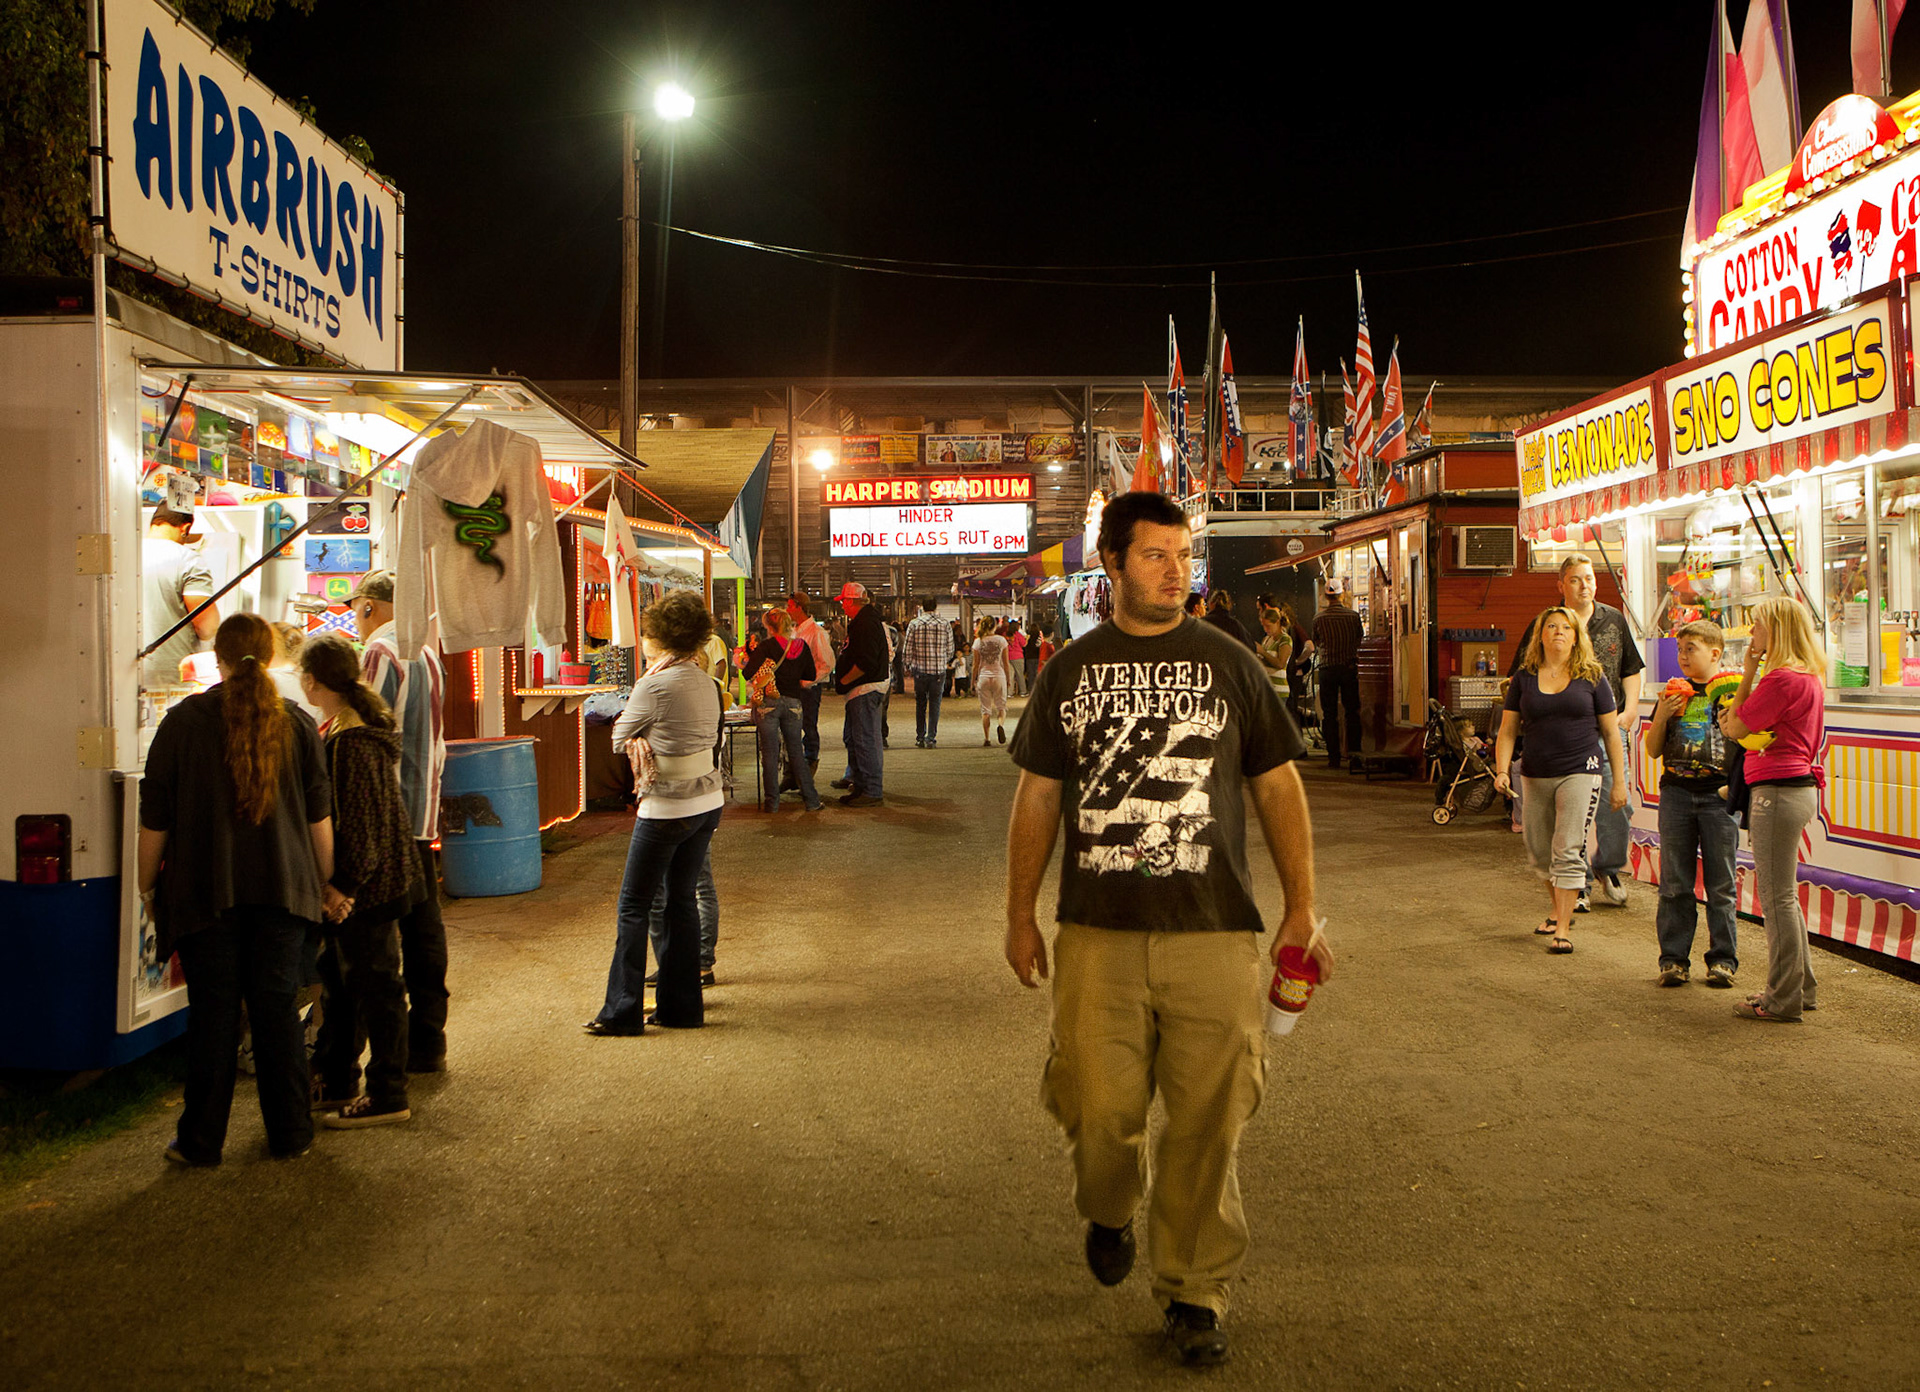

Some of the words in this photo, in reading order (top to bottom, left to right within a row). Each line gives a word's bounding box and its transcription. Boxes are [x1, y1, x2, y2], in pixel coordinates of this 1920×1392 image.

[133, 27, 384, 342] AIRBRUSH
[209, 225, 341, 339] T-SHIRTS
[1724, 226, 1799, 303] COTTON
[1672, 371, 1740, 456] SNO
[1748, 317, 1887, 433] CONES
[1548, 399, 1655, 488] LEMONADE
[826, 481, 919, 502] HARPER
[929, 479, 1030, 500] STADIUM
[898, 508, 953, 523] HINDER
[832, 532, 889, 548] MIDDLE
[895, 531, 949, 546] CLASS
[958, 530, 990, 545] RUT
[993, 535, 1025, 550] 8PM
[962, 567, 993, 575] ABSO
[1075, 661, 1213, 695] AVENGED
[1060, 690, 1229, 735] SEVENFOLD
